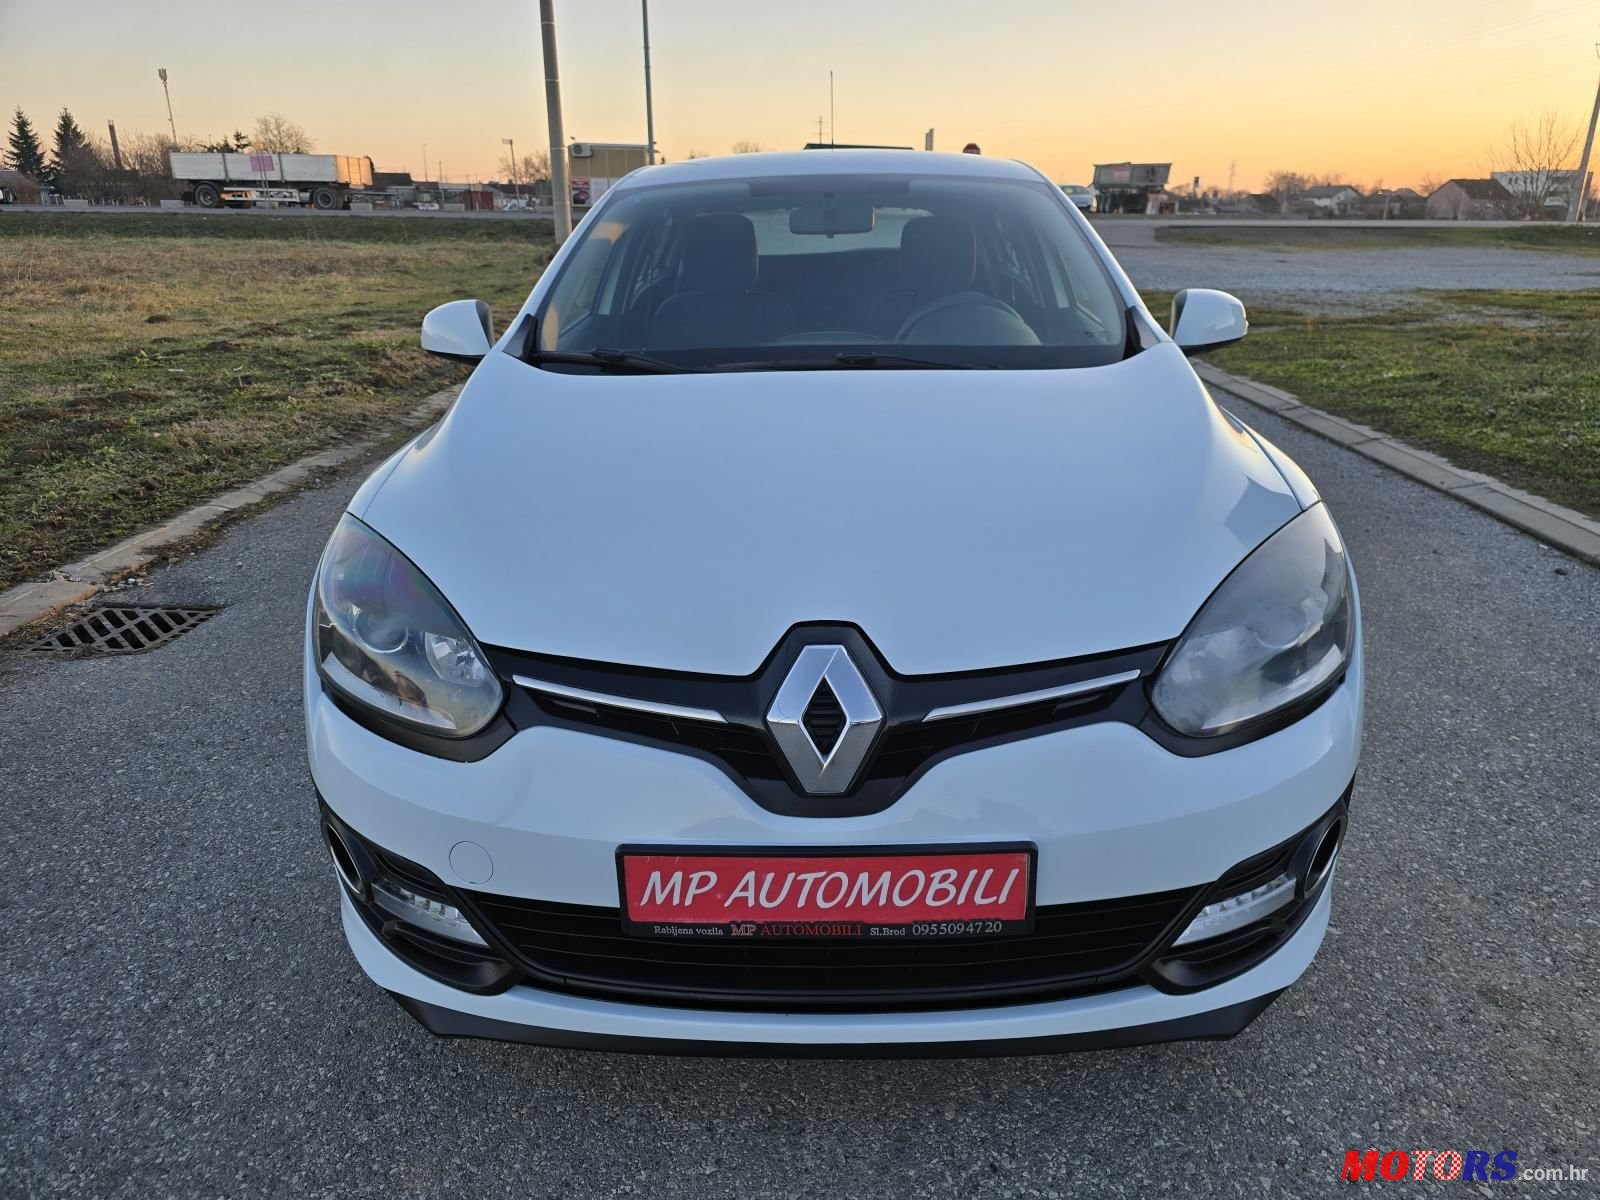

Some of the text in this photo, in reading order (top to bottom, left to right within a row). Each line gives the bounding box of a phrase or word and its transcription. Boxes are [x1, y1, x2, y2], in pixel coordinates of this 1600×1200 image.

[640, 867, 1020, 909] MP AUTOMOBILI
[654, 924, 694, 937] Rabljena
[695, 925, 724, 936] vozila
[730, 924, 757, 936] MP
[760, 924, 863, 936] AUTOMOBILI
[912, 921, 1002, 937] 0955094720
